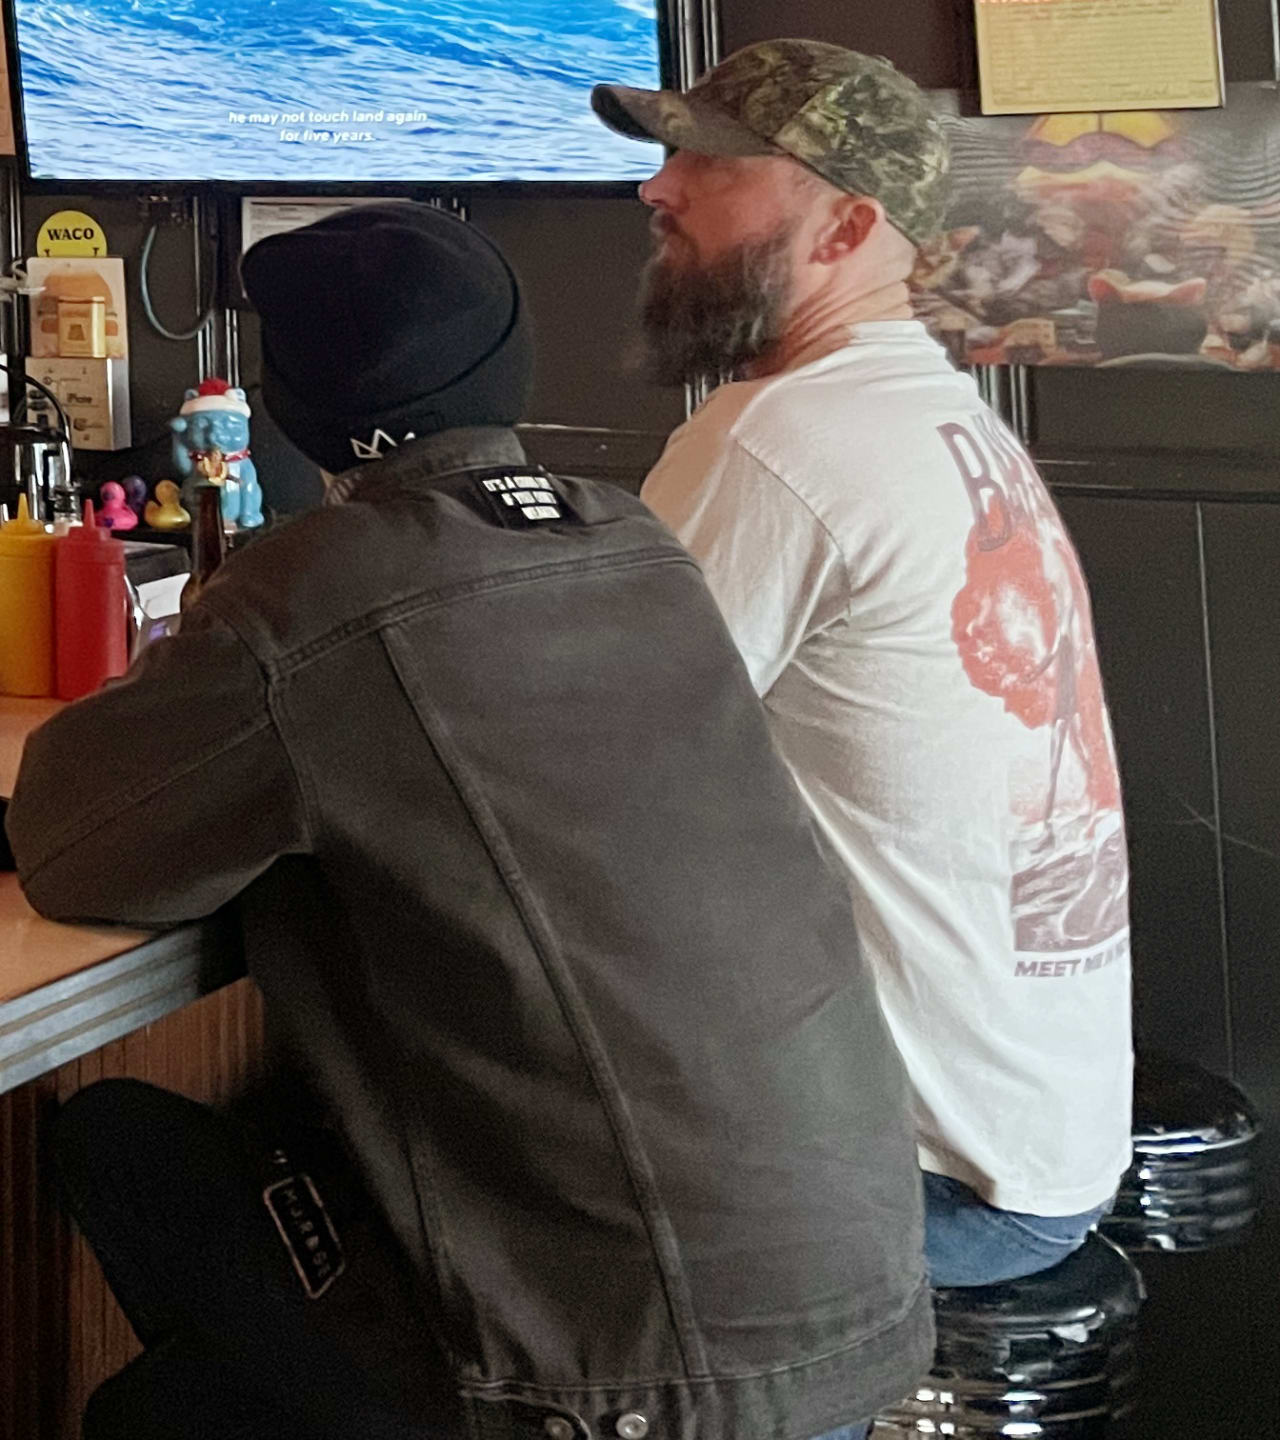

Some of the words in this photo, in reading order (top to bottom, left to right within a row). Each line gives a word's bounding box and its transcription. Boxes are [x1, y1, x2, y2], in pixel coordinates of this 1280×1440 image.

[229, 112, 246, 124] he
[249, 112, 278, 126] may
[282, 111, 304, 122] not
[308, 110, 349, 122] touch
[353, 110, 383, 122] land
[387, 110, 427, 126] again
[280, 130, 299, 141] for
[303, 130, 330, 141] five
[46, 227, 95, 241] WACO
[1013, 958, 1080, 978] MEET
